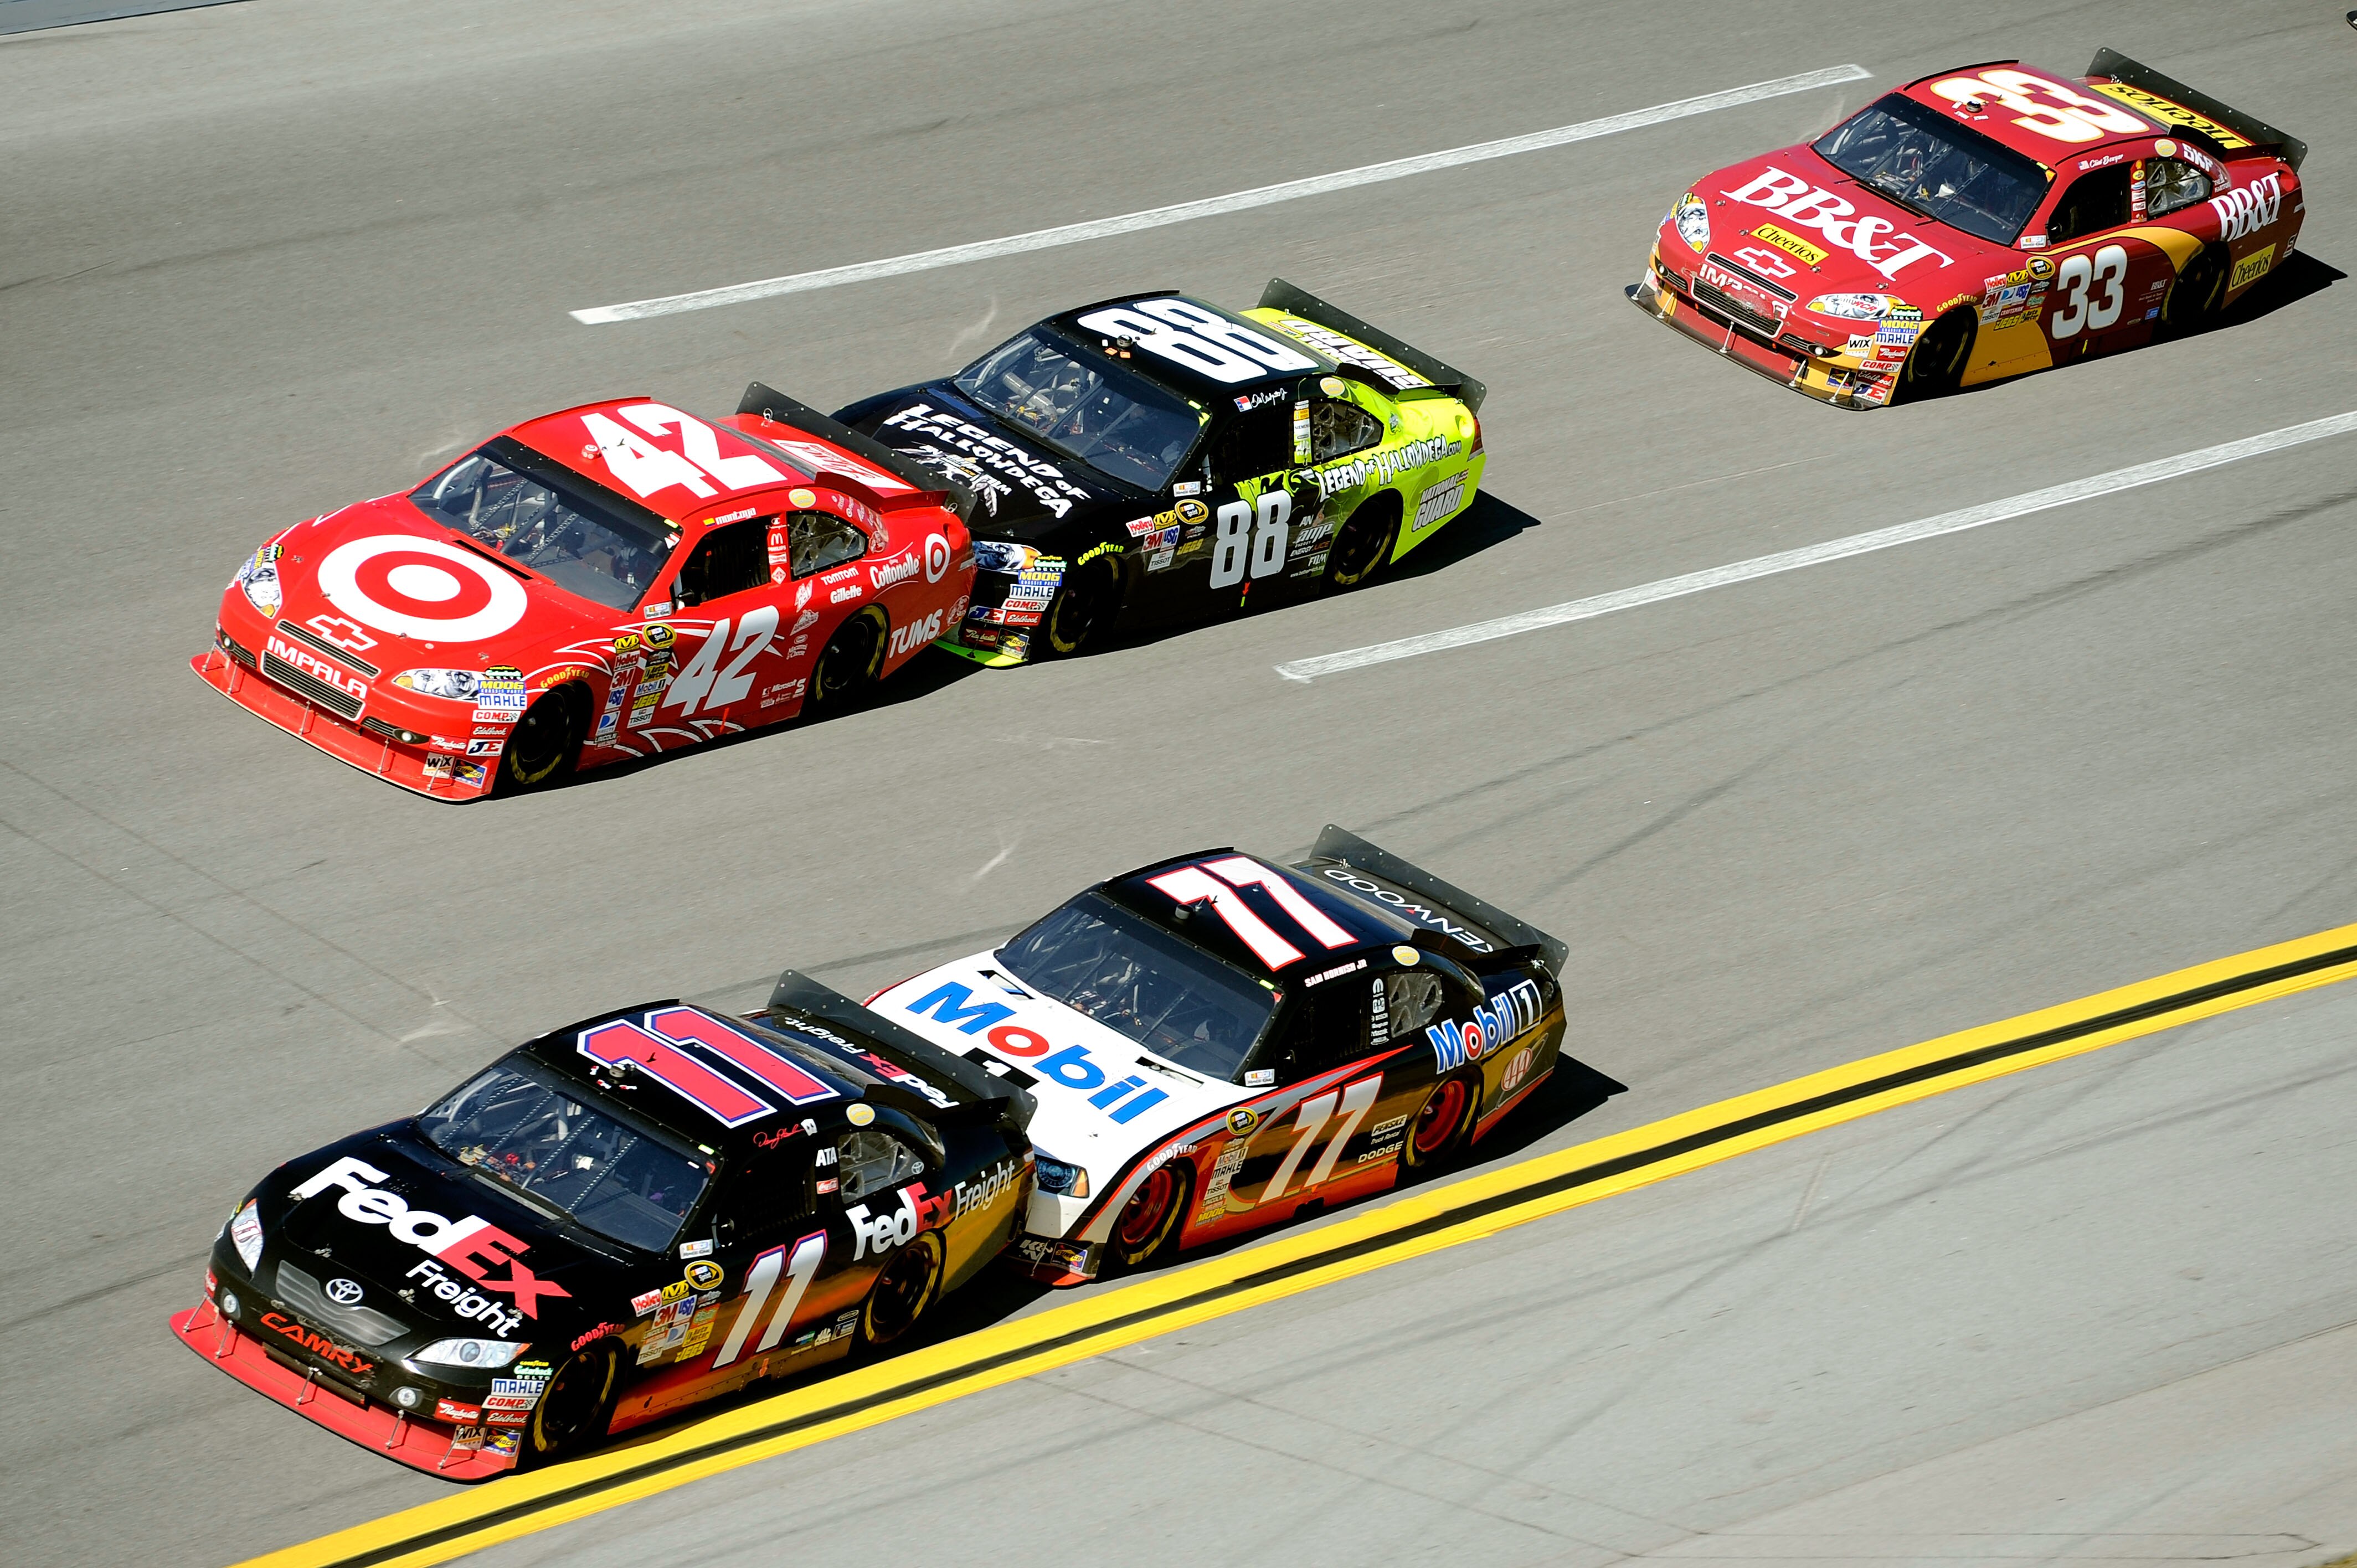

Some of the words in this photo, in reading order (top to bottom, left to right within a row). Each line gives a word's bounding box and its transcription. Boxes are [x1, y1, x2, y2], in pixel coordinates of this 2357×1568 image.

[1930, 69, 2150, 143] 33
[2182, 143, 2214, 172] SKF
[2208, 172, 2281, 242] BB&T
[1720, 166, 1955, 281] BB&T
[1756, 225, 1819, 263] Cheerios
[2231, 254, 2271, 287] Cheerios
[1982, 291, 2002, 308] 3M
[2051, 244, 2128, 339] 33
[1937, 293, 1977, 312] GOODYEAR
[1880, 319, 1919, 329] MOOG
[1982, 312, 2000, 322] TISSOT
[1077, 299, 1319, 383] 88
[1849, 339, 1871, 348] WIX
[1876, 333, 1914, 344] MAHLE
[1862, 360, 1892, 370] COMP
[580, 403, 788, 498] 42
[902, 403, 1063, 478] LEGEND
[884, 412, 1073, 519] HALLOWDEGA
[1314, 458, 1367, 502] LEGEND
[1420, 472, 1459, 505] NATIONAL
[714, 507, 757, 525] montoya
[1412, 483, 1465, 533] GUARD
[1129, 520, 1154, 533] Holley
[1143, 531, 1163, 550] 3M
[1210, 489, 1291, 589] 88
[1077, 541, 1124, 566] GOODYEAR
[1151, 556, 1171, 566] TISSOT
[1308, 553, 1326, 566] FILM
[869, 552, 920, 590] Cottonelle
[1019, 572, 1060, 581] MOOG
[830, 585, 862, 604] Gillette
[1011, 585, 1053, 598] MAHLE
[969, 607, 1004, 621] JE
[1005, 600, 1038, 608] COMP
[1007, 614, 1039, 623] Edelbrock
[888, 608, 943, 659] TUMS
[1000, 636, 1026, 646] SUNOCO
[266, 635, 368, 699] IMPALA
[616, 654, 640, 669] Holley
[661, 605, 780, 718] 42
[479, 680, 524, 690] MOOG
[540, 666, 590, 689] GOODYEAR
[611, 669, 634, 688] 3M
[637, 681, 657, 694] Mobil
[479, 695, 526, 707] MAHLE
[476, 711, 509, 720] COMP
[630, 713, 652, 724] TISSOT
[472, 726, 507, 736] Edelbrock
[468, 741, 501, 754] JE
[1145, 856, 1358, 971] 77
[1304, 973, 1324, 988] SAM
[1356, 958, 1367, 970] JR
[784, 1017, 866, 1054] Freight
[1425, 993, 1516, 1075] Mobil
[905, 982, 1170, 1125] Mobil
[577, 1006, 841, 1129] 11
[857, 1052, 960, 1109] FedEx
[1258, 1072, 1383, 1204] 77
[815, 1146, 838, 1167] ATA
[1146, 1142, 1198, 1172] GOODYEAR
[1357, 1140, 1404, 1163] DODGE
[1211, 1159, 1244, 1180] MAHLE
[1207, 1183, 1228, 1195] TISSOT
[846, 1182, 953, 1261] FedEx
[954, 1159, 1015, 1221] Freight
[1196, 1206, 1226, 1222] MOOG
[289, 1157, 573, 1321] FedEx
[1056, 1250, 1083, 1261] SUNOCO
[405, 1258, 521, 1339] Freight
[632, 1293, 661, 1311] Holley
[712, 1229, 828, 1371] 11
[654, 1302, 679, 1327] 3M
[260, 1312, 374, 1373] CAMRY
[570, 1322, 626, 1352] GOODYEAR
[639, 1347, 663, 1360] TISSOT
[493, 1380, 543, 1394] MAHLE
[487, 1396, 526, 1407] COMP
[487, 1412, 527, 1424] Edelbrock
[487, 1435, 517, 1447] SUNOCO
